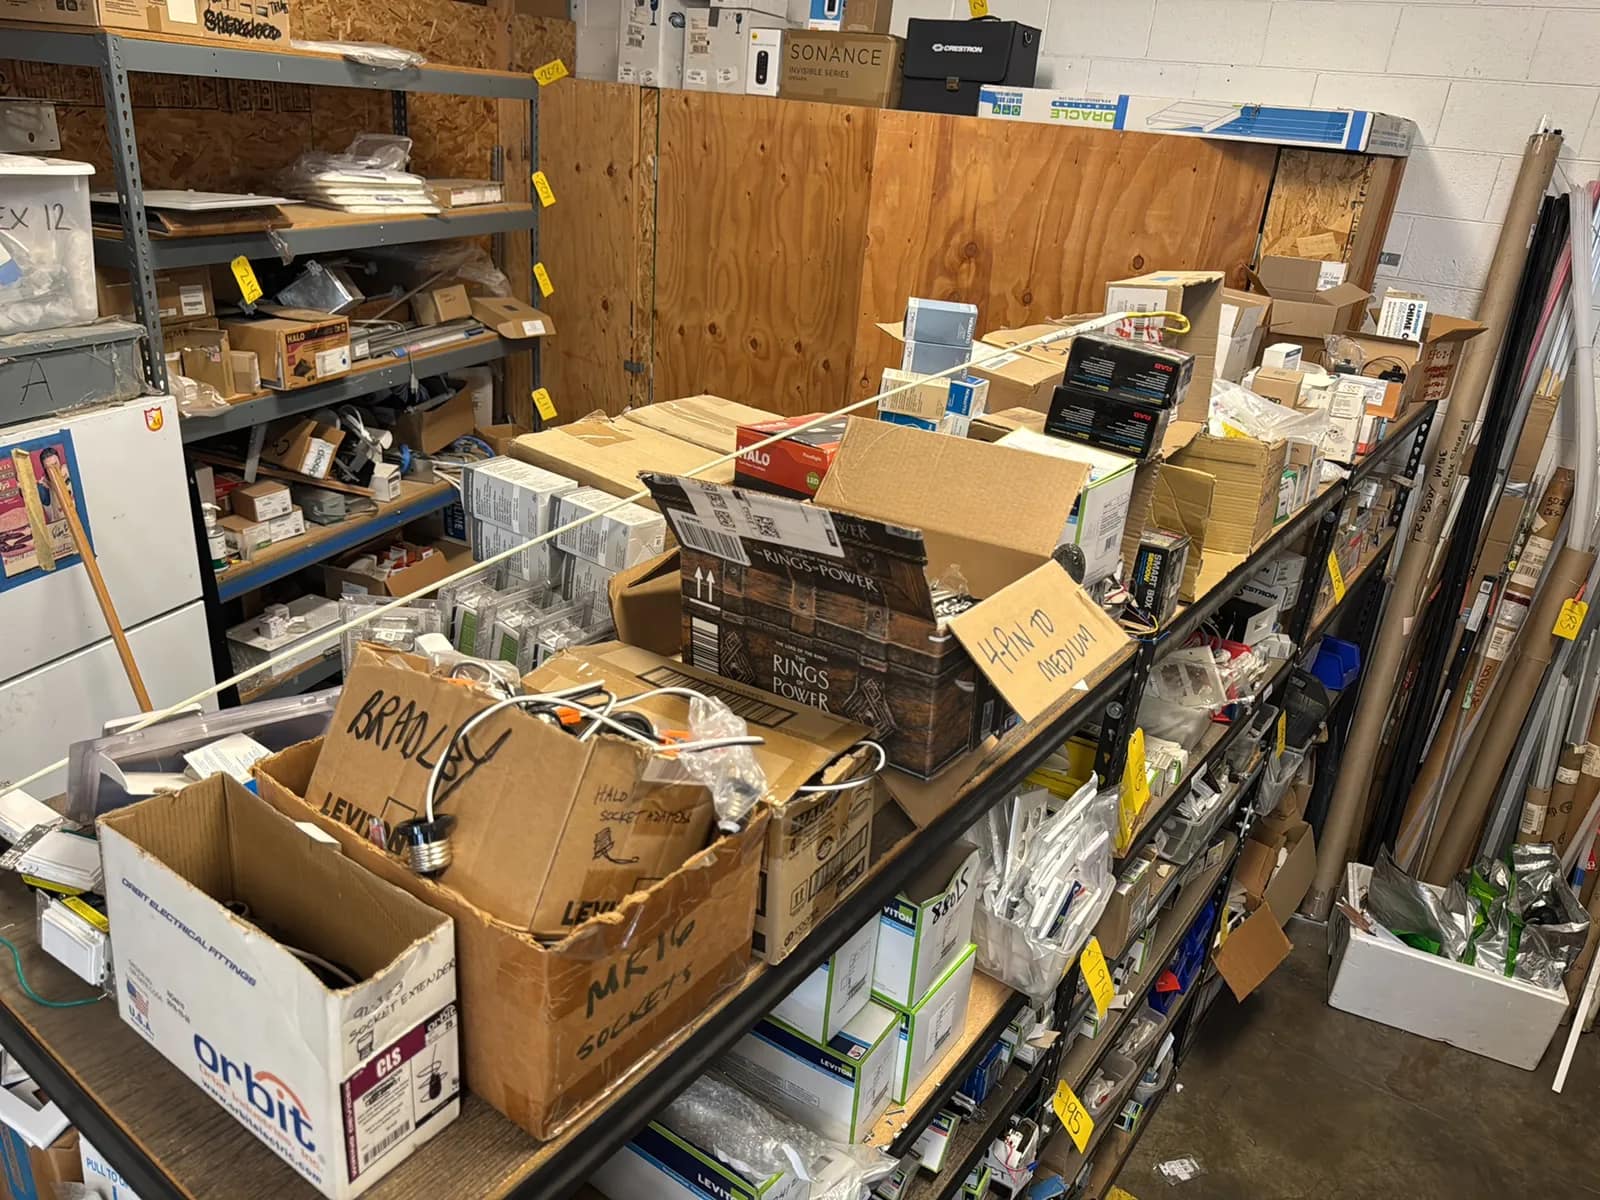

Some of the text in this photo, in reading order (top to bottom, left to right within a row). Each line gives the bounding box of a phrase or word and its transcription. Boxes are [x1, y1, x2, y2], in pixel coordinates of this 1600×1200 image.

[790, 43, 882, 66] SONANCE
[944, 45, 983, 54] CRESTRON
[824, 68, 849, 78] SERIES
[1051, 109, 1116, 123] ORACLE
[44, 203, 71, 231] 12
[1402, 302, 1416, 336] CHIME
[287, 333, 305, 344] HALO
[20, 358, 54, 405] A
[738, 445, 770, 466] HALO
[1433, 449, 1448, 478] WINE
[764, 549, 812, 571] RINGS
[819, 565, 878, 593] POWER
[1149, 553, 1162, 587] SMART
[1144, 589, 1156, 609] BOX
[1242, 585, 1278, 600] ESTRON
[977, 609, 1054, 674] 4-PIN TO
[1037, 624, 1097, 682] MEDIUM
[773, 654, 830, 690] RINGS
[773, 676, 830, 712] POWER
[600, 810, 645, 824] SOCKET
[560, 900, 619, 926] LEVI
[883, 905, 916, 924] VITON
[121, 878, 149, 902] ORBIT
[149, 899, 208, 950] ELECTRICAL
[208, 945, 257, 987] FITTINGS
[376, 1047, 402, 1078] CLS
[820, 1058, 853, 1078] LEVITON
[1061, 1095, 1084, 1135] 195
[86, 1157, 118, 1181] PULL TO
[697, 1172, 739, 1200] LEVIT
